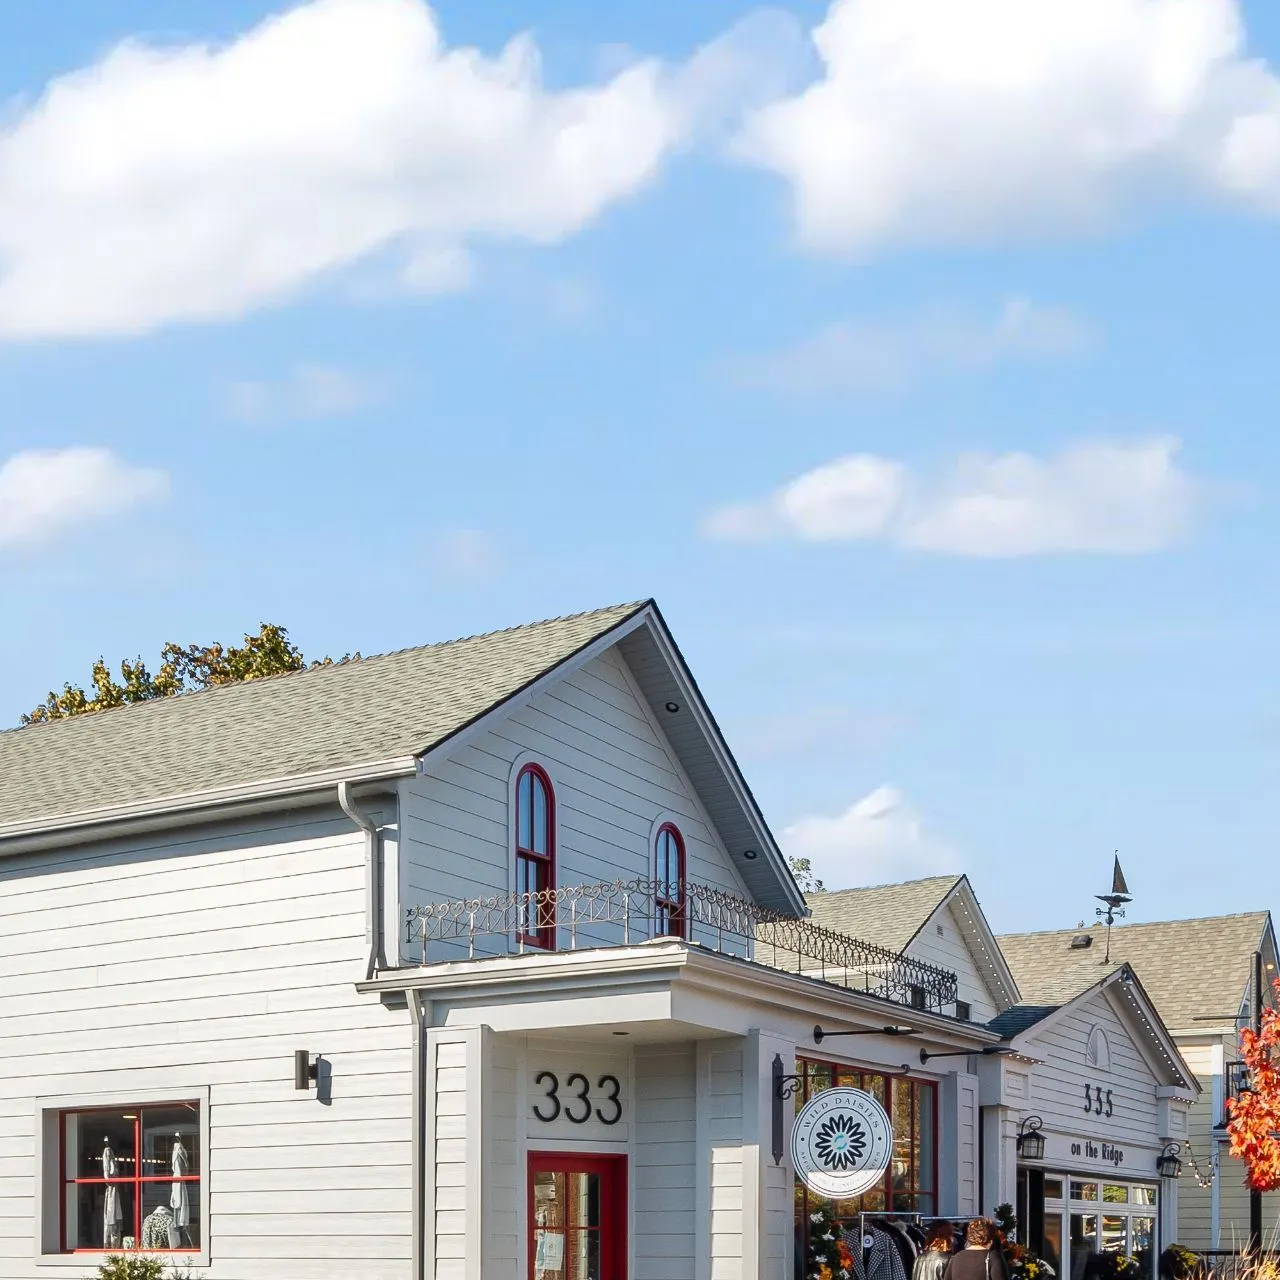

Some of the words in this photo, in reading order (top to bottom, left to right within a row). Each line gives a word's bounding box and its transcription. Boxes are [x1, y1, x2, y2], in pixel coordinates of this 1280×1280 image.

[533, 1071, 622, 1125] 333
[803, 1102, 829, 1128] WILD
[835, 1097, 880, 1129] DAISIES
[1084, 1083, 1113, 1118] 335
[1071, 1143, 1081, 1155] on
[1085, 1141, 1098, 1158] the
[1101, 1143, 1124, 1166] Ridge
